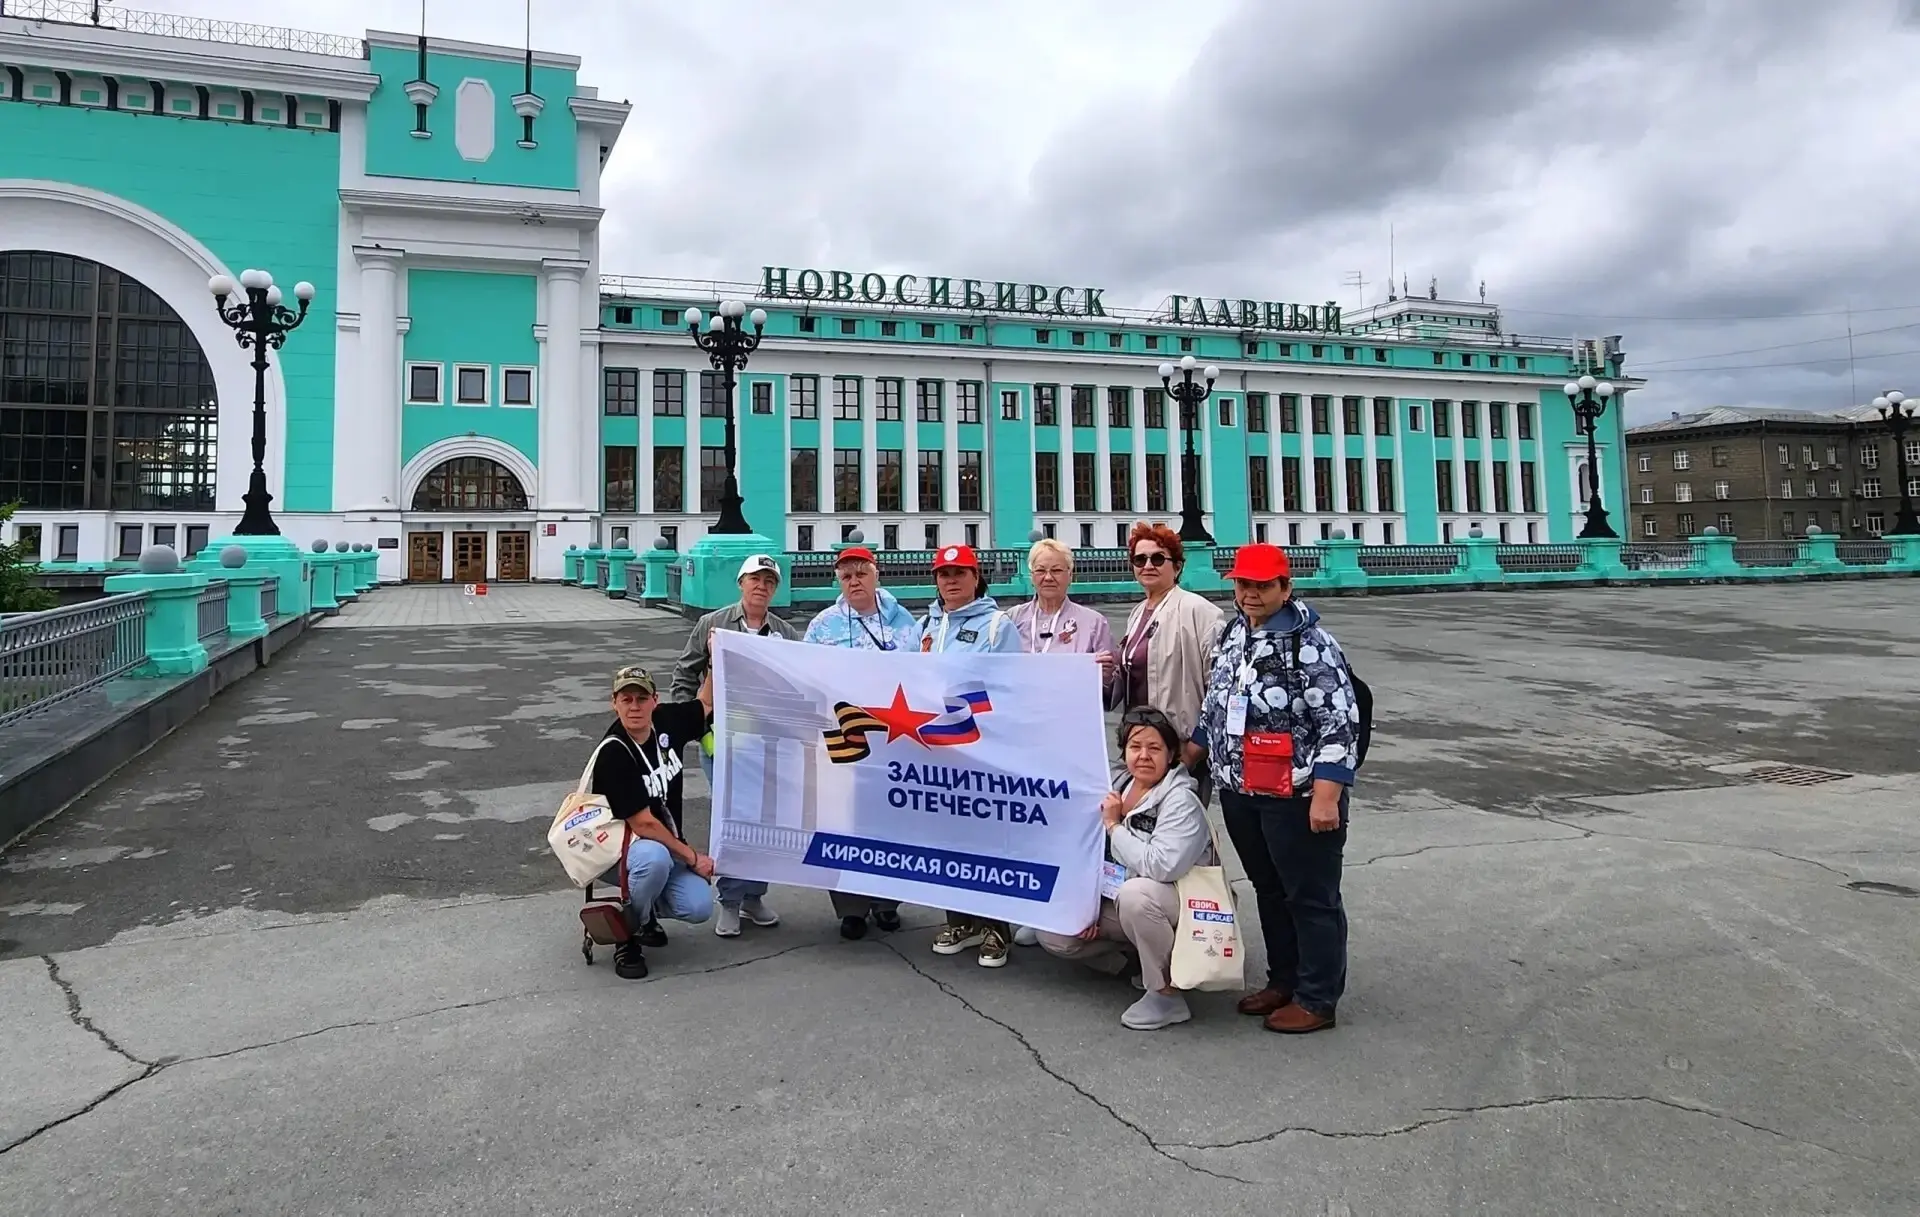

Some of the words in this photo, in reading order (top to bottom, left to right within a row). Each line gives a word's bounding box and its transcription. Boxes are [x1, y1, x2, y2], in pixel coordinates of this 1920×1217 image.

[762, 266, 1106, 316] НОВОСИБИРСК
[1172, 294, 1342, 332] ГЛАВНЫЙ
[888, 761, 1070, 799] ЗАЩИТНИКИ
[888, 788, 1048, 826] ОТЕЧЕСТВА
[821, 842, 941, 876] КИРОВСКАЯ
[946, 860, 1042, 891] ОБЛАСТЬ
[1190, 900, 1217, 910] СВОИХ
